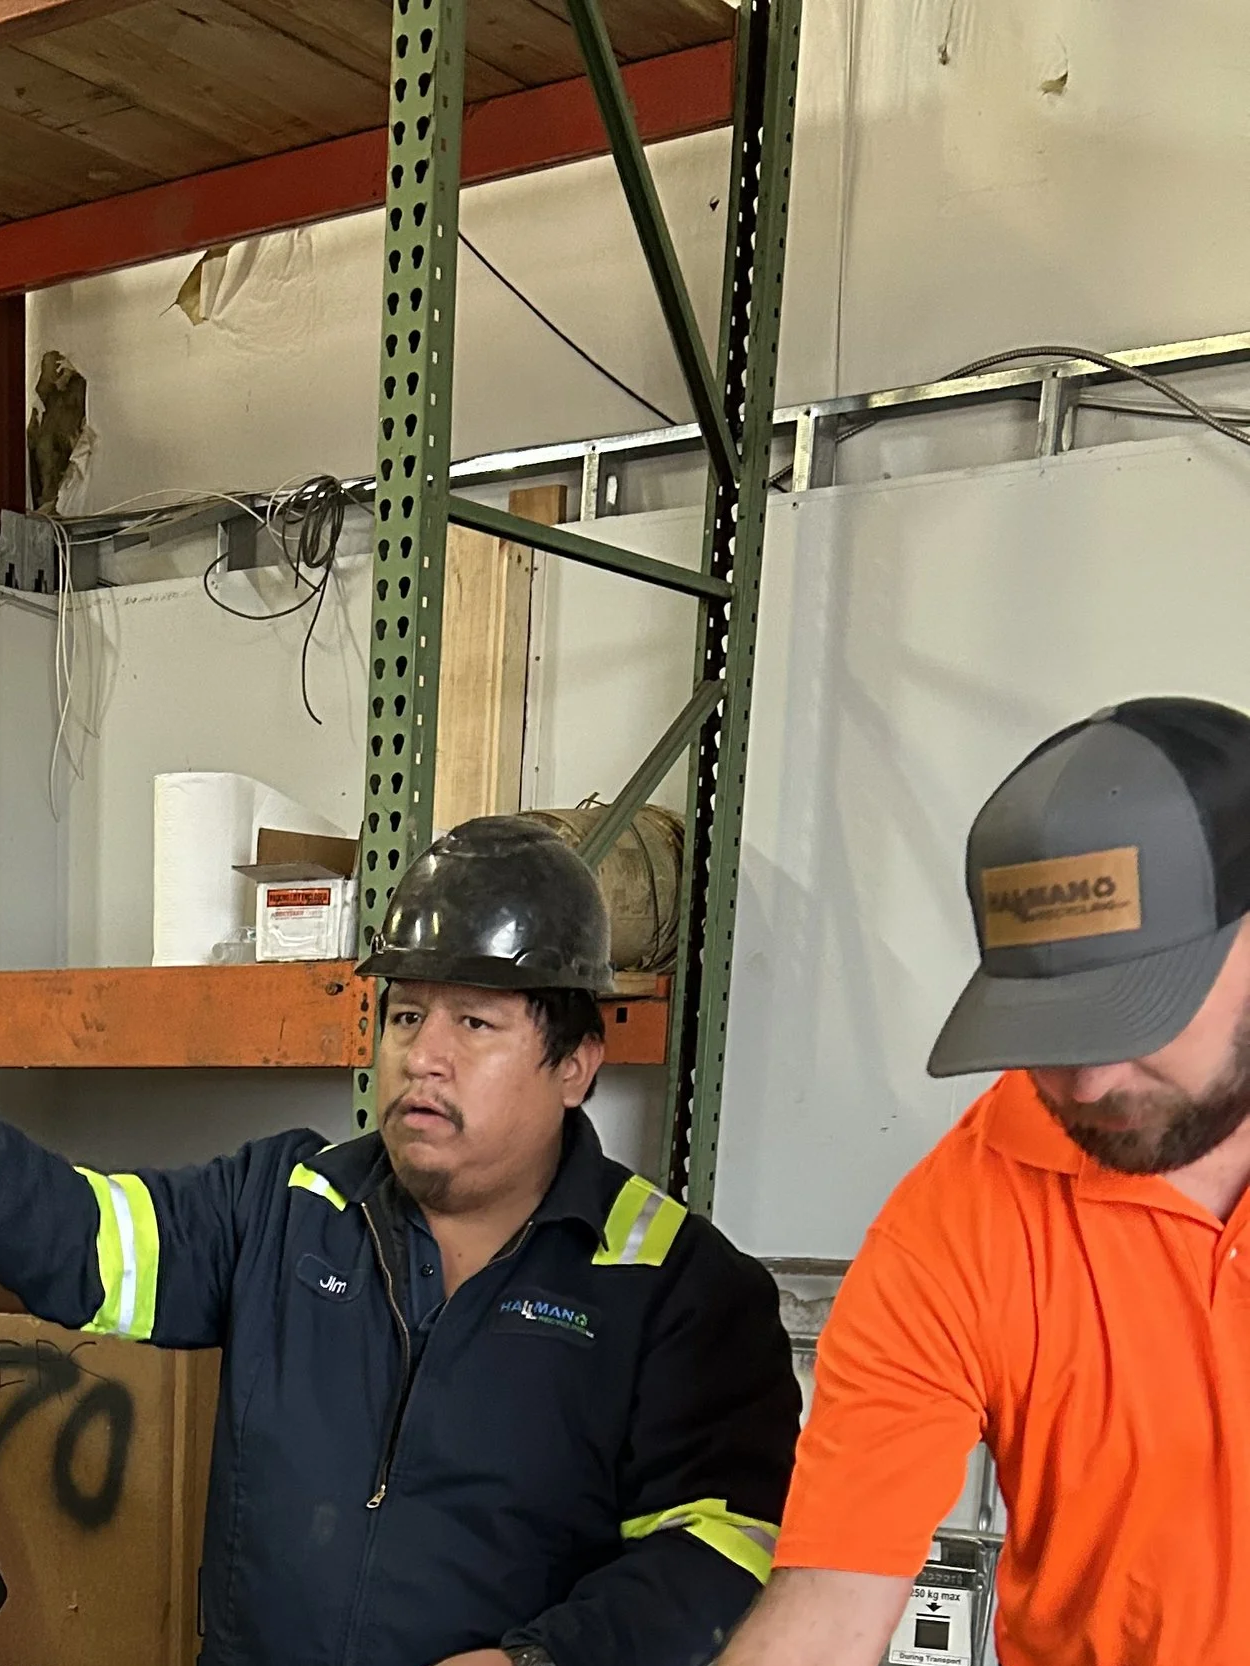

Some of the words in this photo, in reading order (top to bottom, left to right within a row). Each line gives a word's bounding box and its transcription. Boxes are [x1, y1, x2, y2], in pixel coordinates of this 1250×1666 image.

[319, 1275, 348, 1294] Jim
[500, 1300, 575, 1322] HALLMAN
[927, 1590, 939, 1601] kg
[941, 1593, 961, 1601] max
[899, 1652, 924, 1663] During
[925, 1654, 962, 1665] Transport
